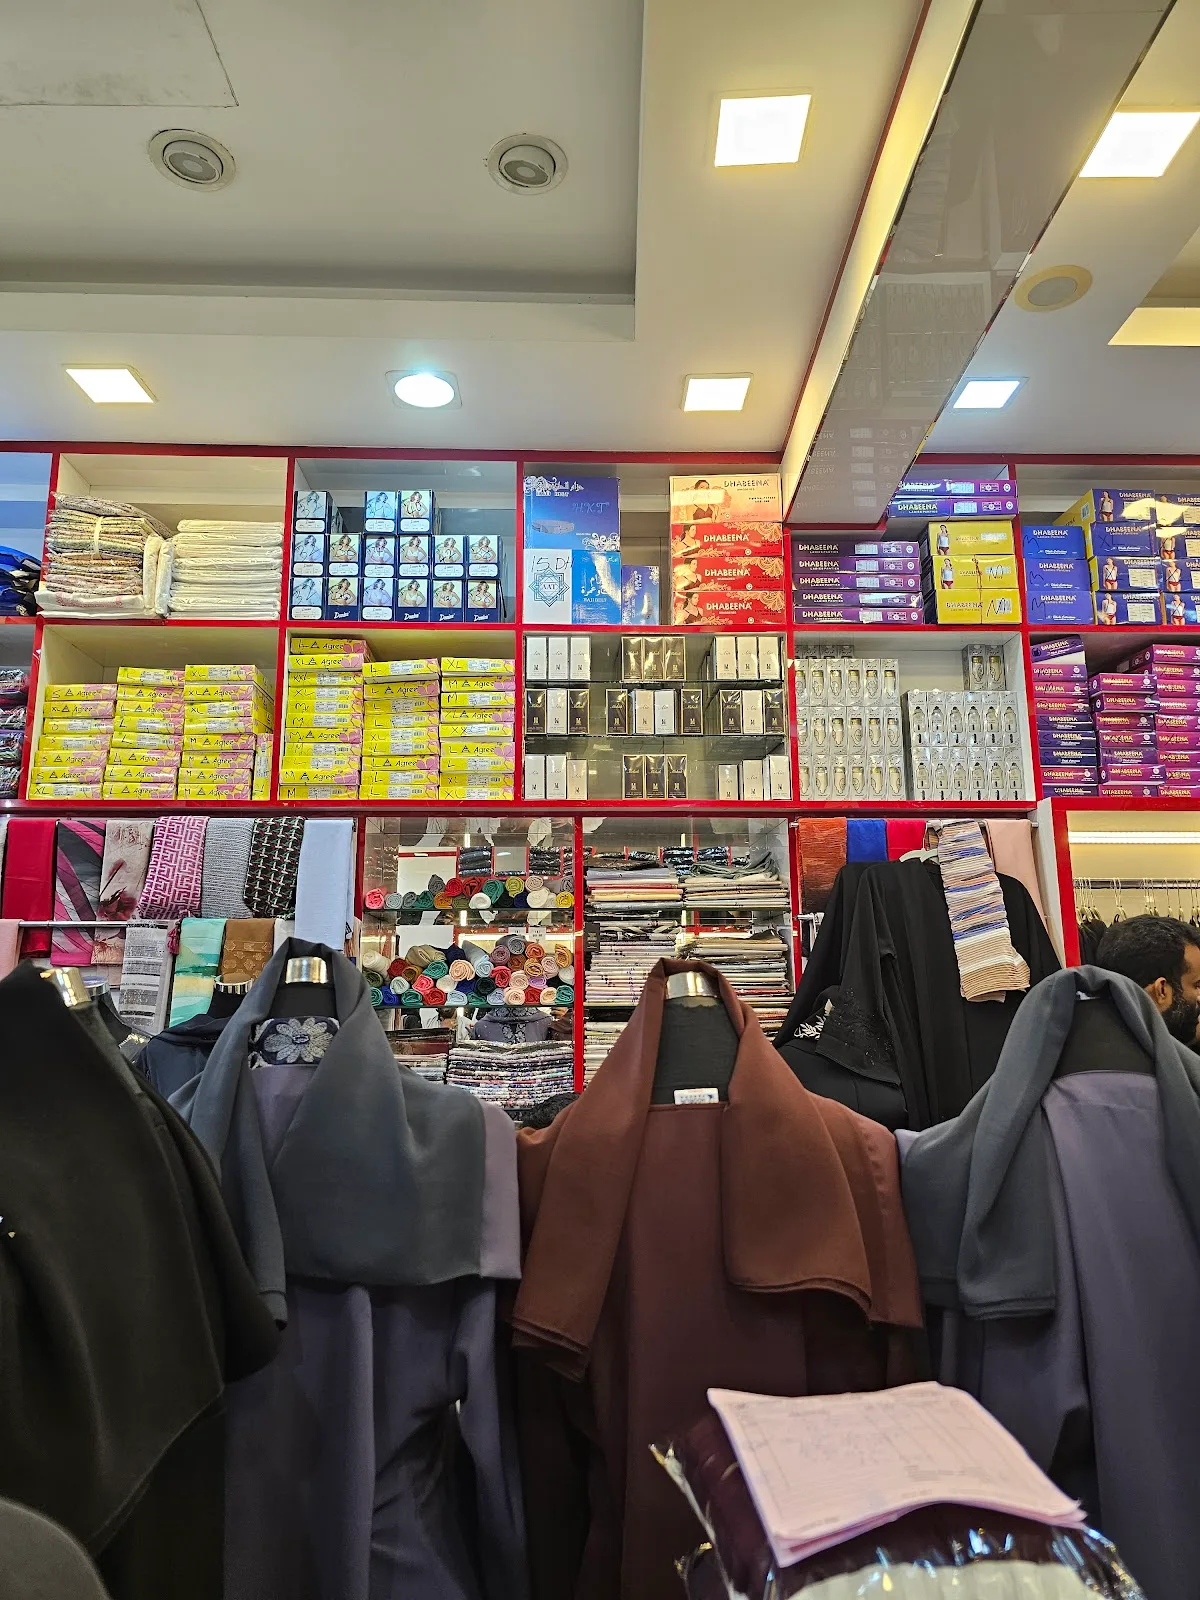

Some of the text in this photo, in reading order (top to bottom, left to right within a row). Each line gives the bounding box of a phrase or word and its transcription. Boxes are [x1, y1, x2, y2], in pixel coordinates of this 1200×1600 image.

[704, 534, 748, 542] DHABEENA
[704, 568, 749, 577] DHABEENA
[706, 602, 751, 611] DHABEENA
[322, 643, 344, 651] Agree
[321, 658, 342, 666] Agree
[448, 660, 462, 669] XL
[450, 680, 459, 689] M
[474, 680, 494, 688] Agree
[397, 686, 417, 695] Agree
[448, 692, 458, 703] M
[472, 712, 492, 720] Agree
[120, 719, 126, 727] L
[450, 746, 457, 754] L
[474, 746, 494, 754] Agree
[140, 755, 160, 763] Agree
[34, 786, 49, 795] XL
[288, 788, 296, 798] M
